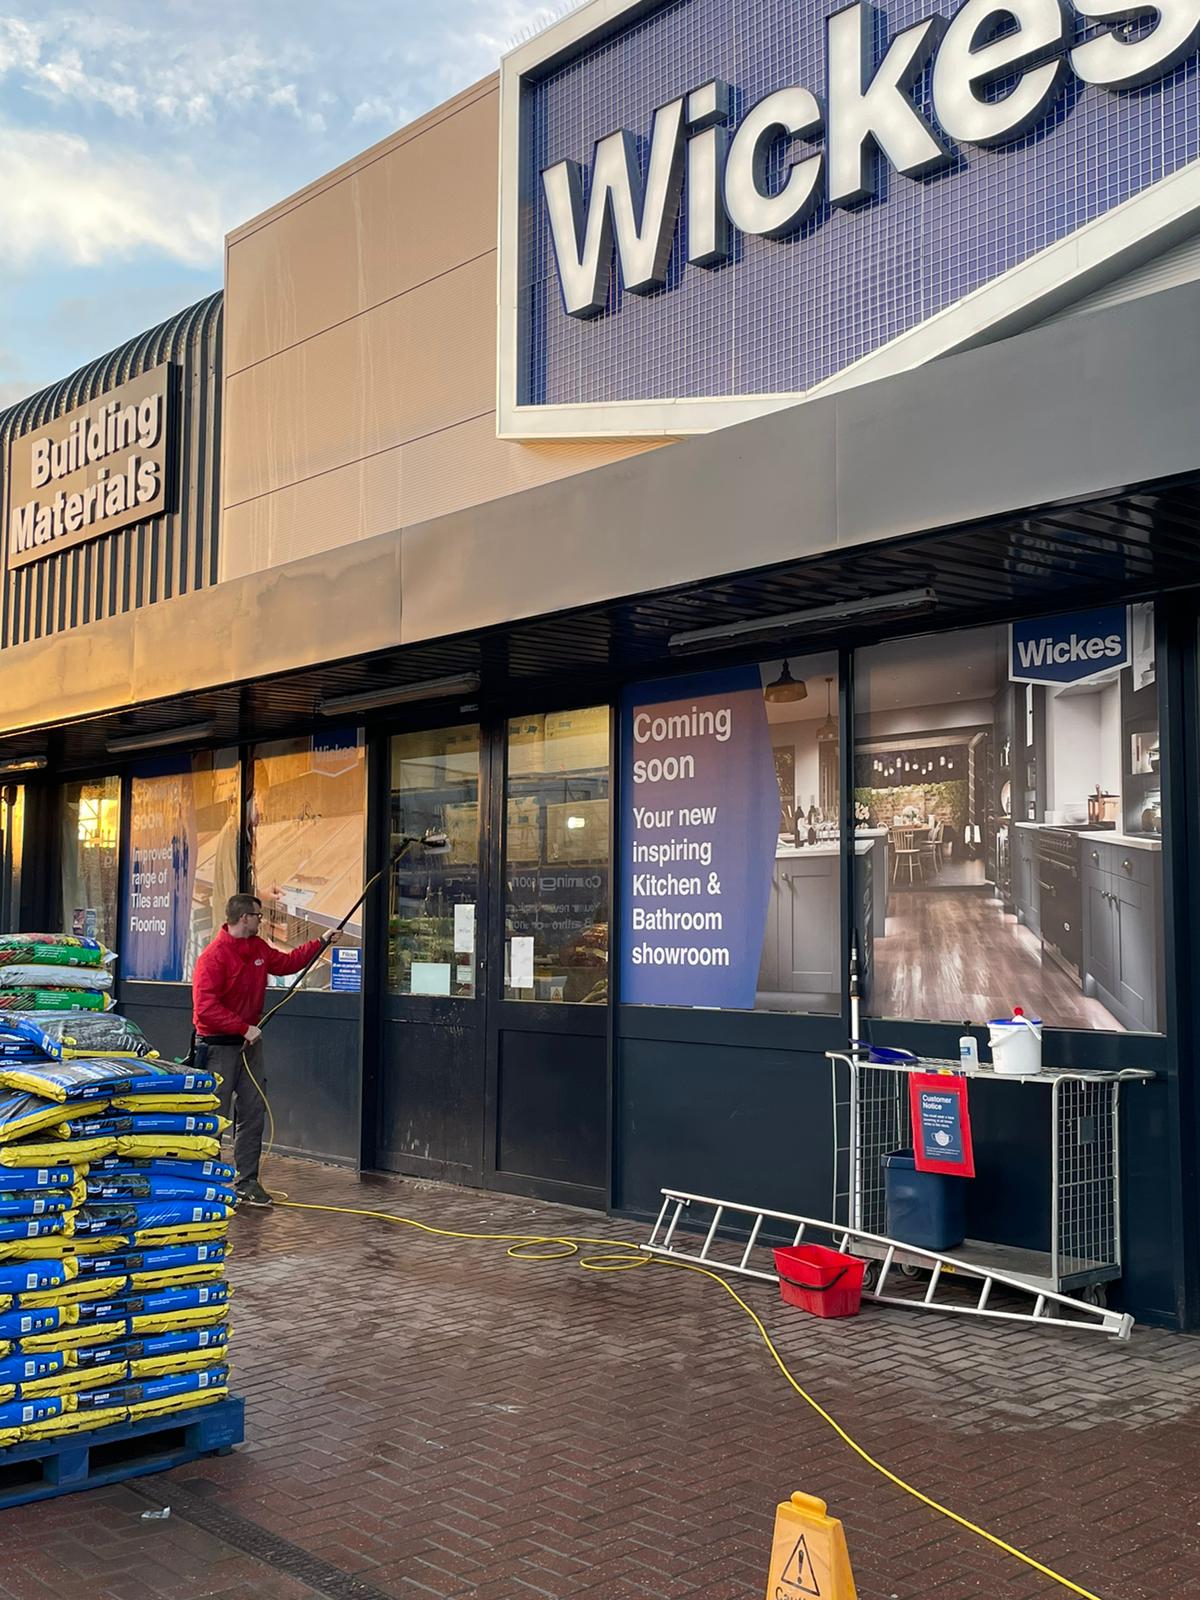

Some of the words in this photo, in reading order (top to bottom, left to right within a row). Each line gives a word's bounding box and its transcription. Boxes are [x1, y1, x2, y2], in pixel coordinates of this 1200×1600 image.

[541, 0, 1200, 319] Wickes
[31, 392, 163, 488] Building
[11, 454, 157, 554] Materials
[1018, 634, 1122, 668] Wickes
[633, 706, 732, 743] Coming
[633, 754, 695, 784] soon
[633, 807, 674, 829] Your
[679, 806, 717, 826] new
[633, 839, 712, 867] inspiring
[132, 871, 157, 888] range
[158, 868, 168, 884] of
[633, 873, 701, 896] Kitchen
[707, 872, 721, 895] &
[131, 893, 151, 908] Tiles
[153, 892, 170, 908] and
[130, 916, 166, 935] Flooring
[632, 908, 723, 931] Bathroom
[632, 942, 730, 966] showroom
